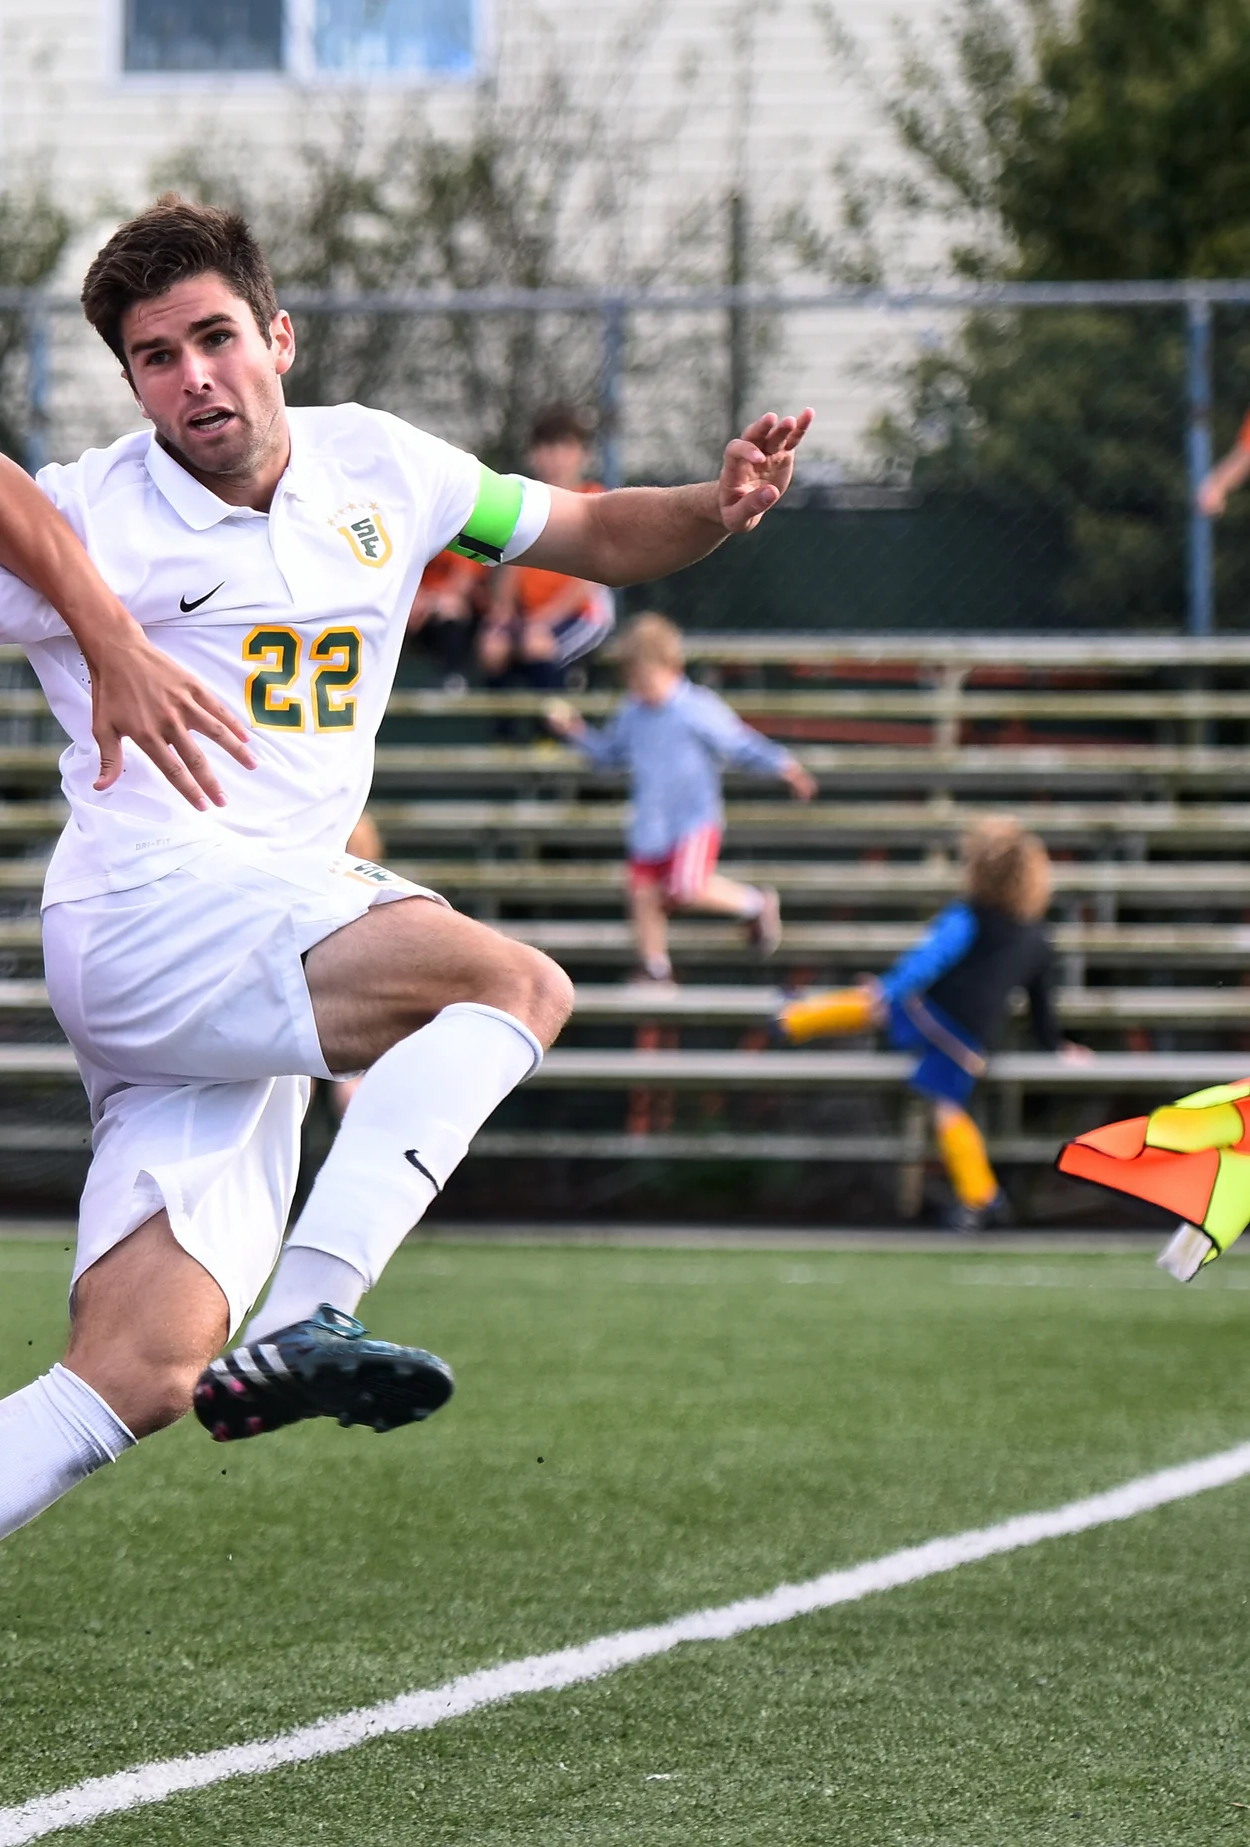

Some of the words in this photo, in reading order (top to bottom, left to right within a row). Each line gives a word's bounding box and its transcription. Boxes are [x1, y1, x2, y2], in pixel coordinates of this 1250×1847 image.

[351, 517, 380, 559] SF
[241, 624, 364, 734] 22
[135, 838, 171, 851] DRI-FIT
